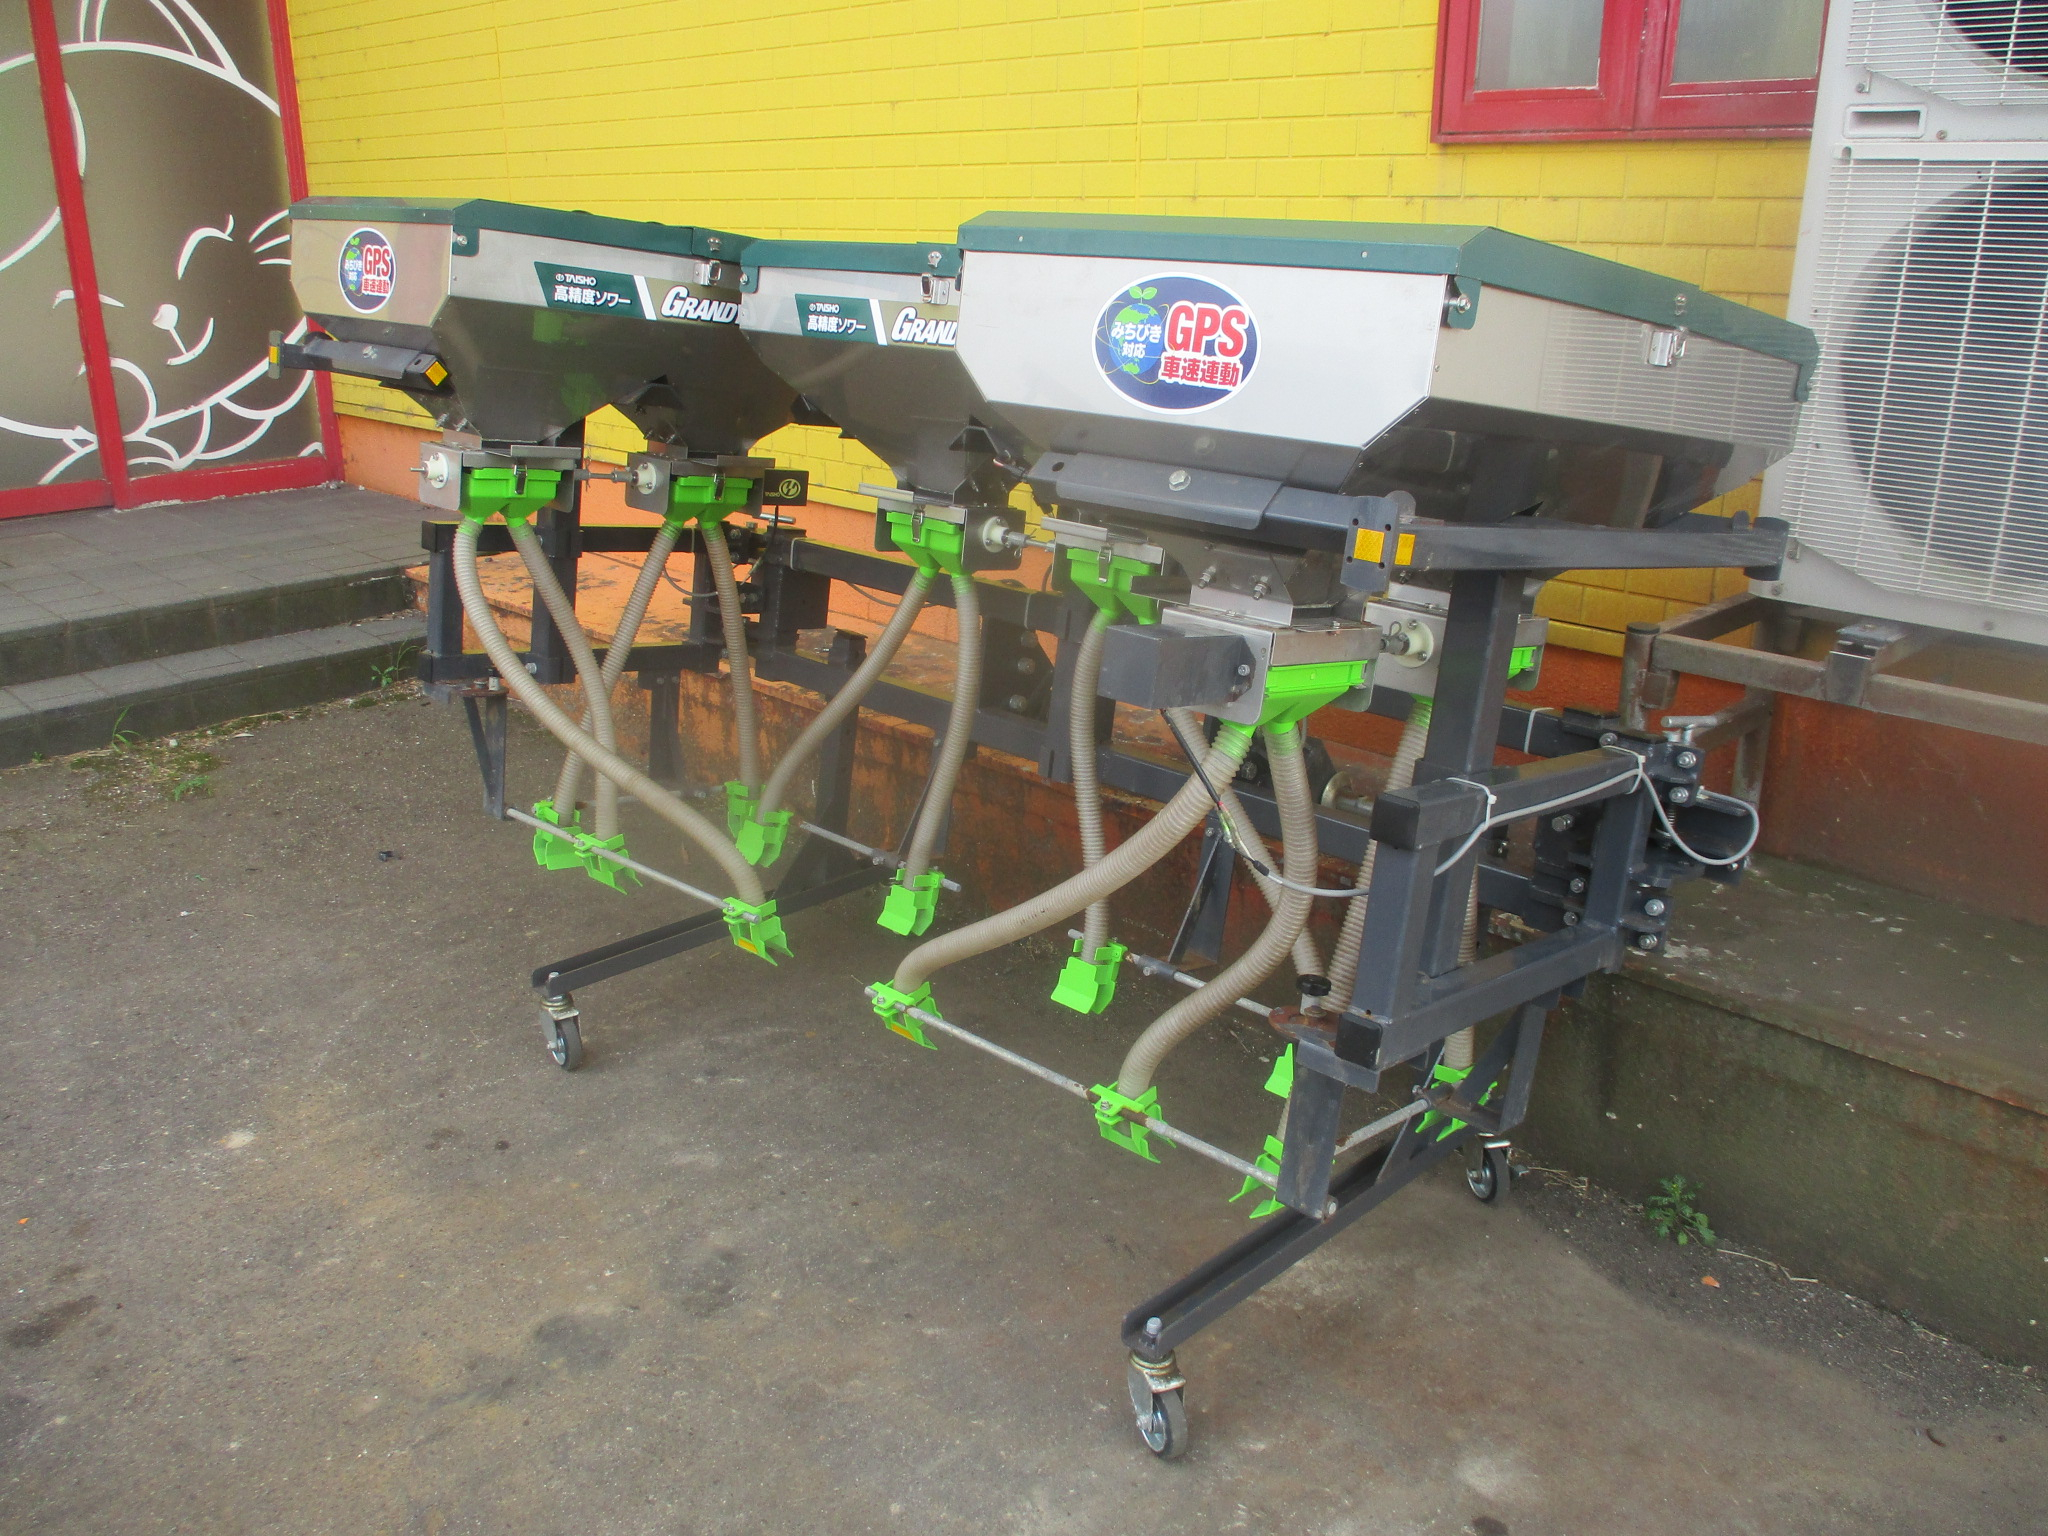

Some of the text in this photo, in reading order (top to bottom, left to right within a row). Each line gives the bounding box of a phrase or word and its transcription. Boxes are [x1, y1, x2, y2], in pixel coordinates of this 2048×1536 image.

[363, 246, 391, 277] GPS
[564, 273, 597, 286] TAISHO
[554, 284, 631, 308] 高精度ソワー
[816, 303, 840, 313] TAISHO
[807, 315, 867, 334] 高精度ソワー
[1110, 321, 1162, 343] みちびき
[1166, 302, 1247, 358] GPS
[1121, 342, 1147, 359] 対応
[1160, 355, 1241, 388] 車速連動
